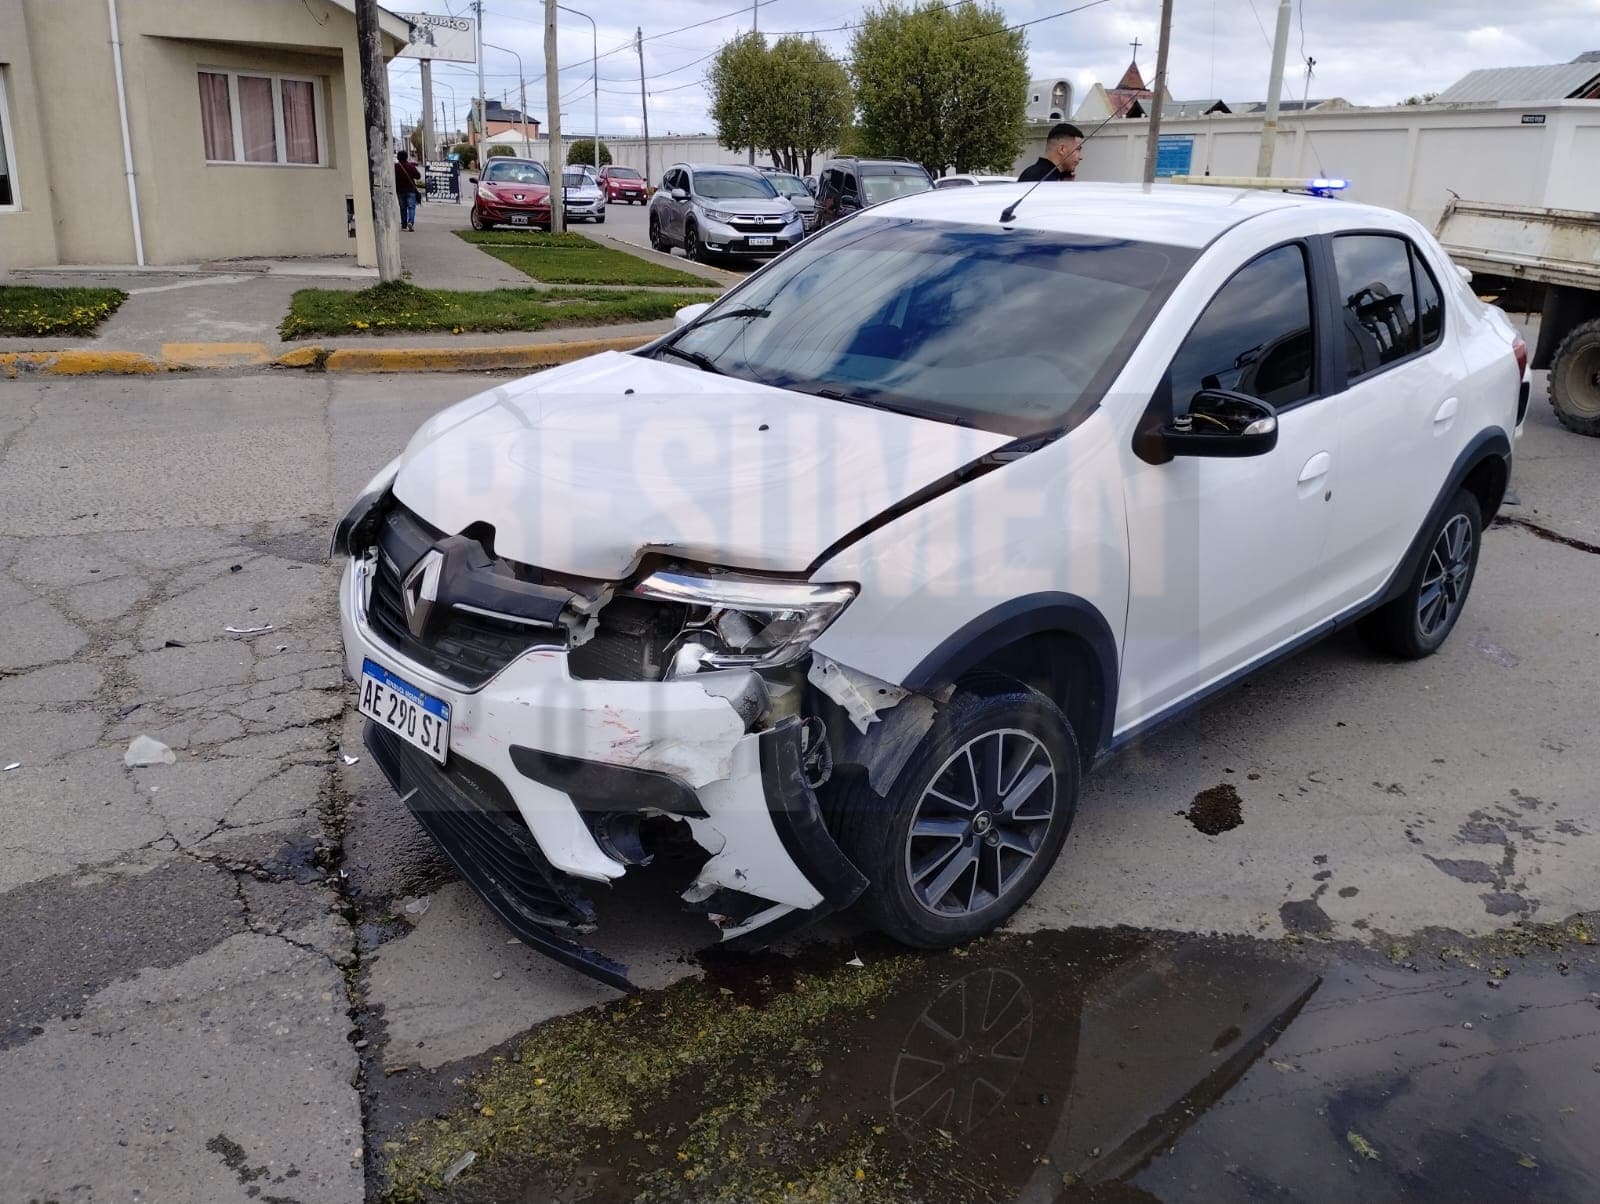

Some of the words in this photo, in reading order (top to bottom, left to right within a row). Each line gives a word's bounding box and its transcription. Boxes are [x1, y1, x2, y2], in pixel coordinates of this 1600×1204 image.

[363, 679, 384, 717] AE
[387, 693, 417, 738] 290
[421, 714, 442, 754] SI
